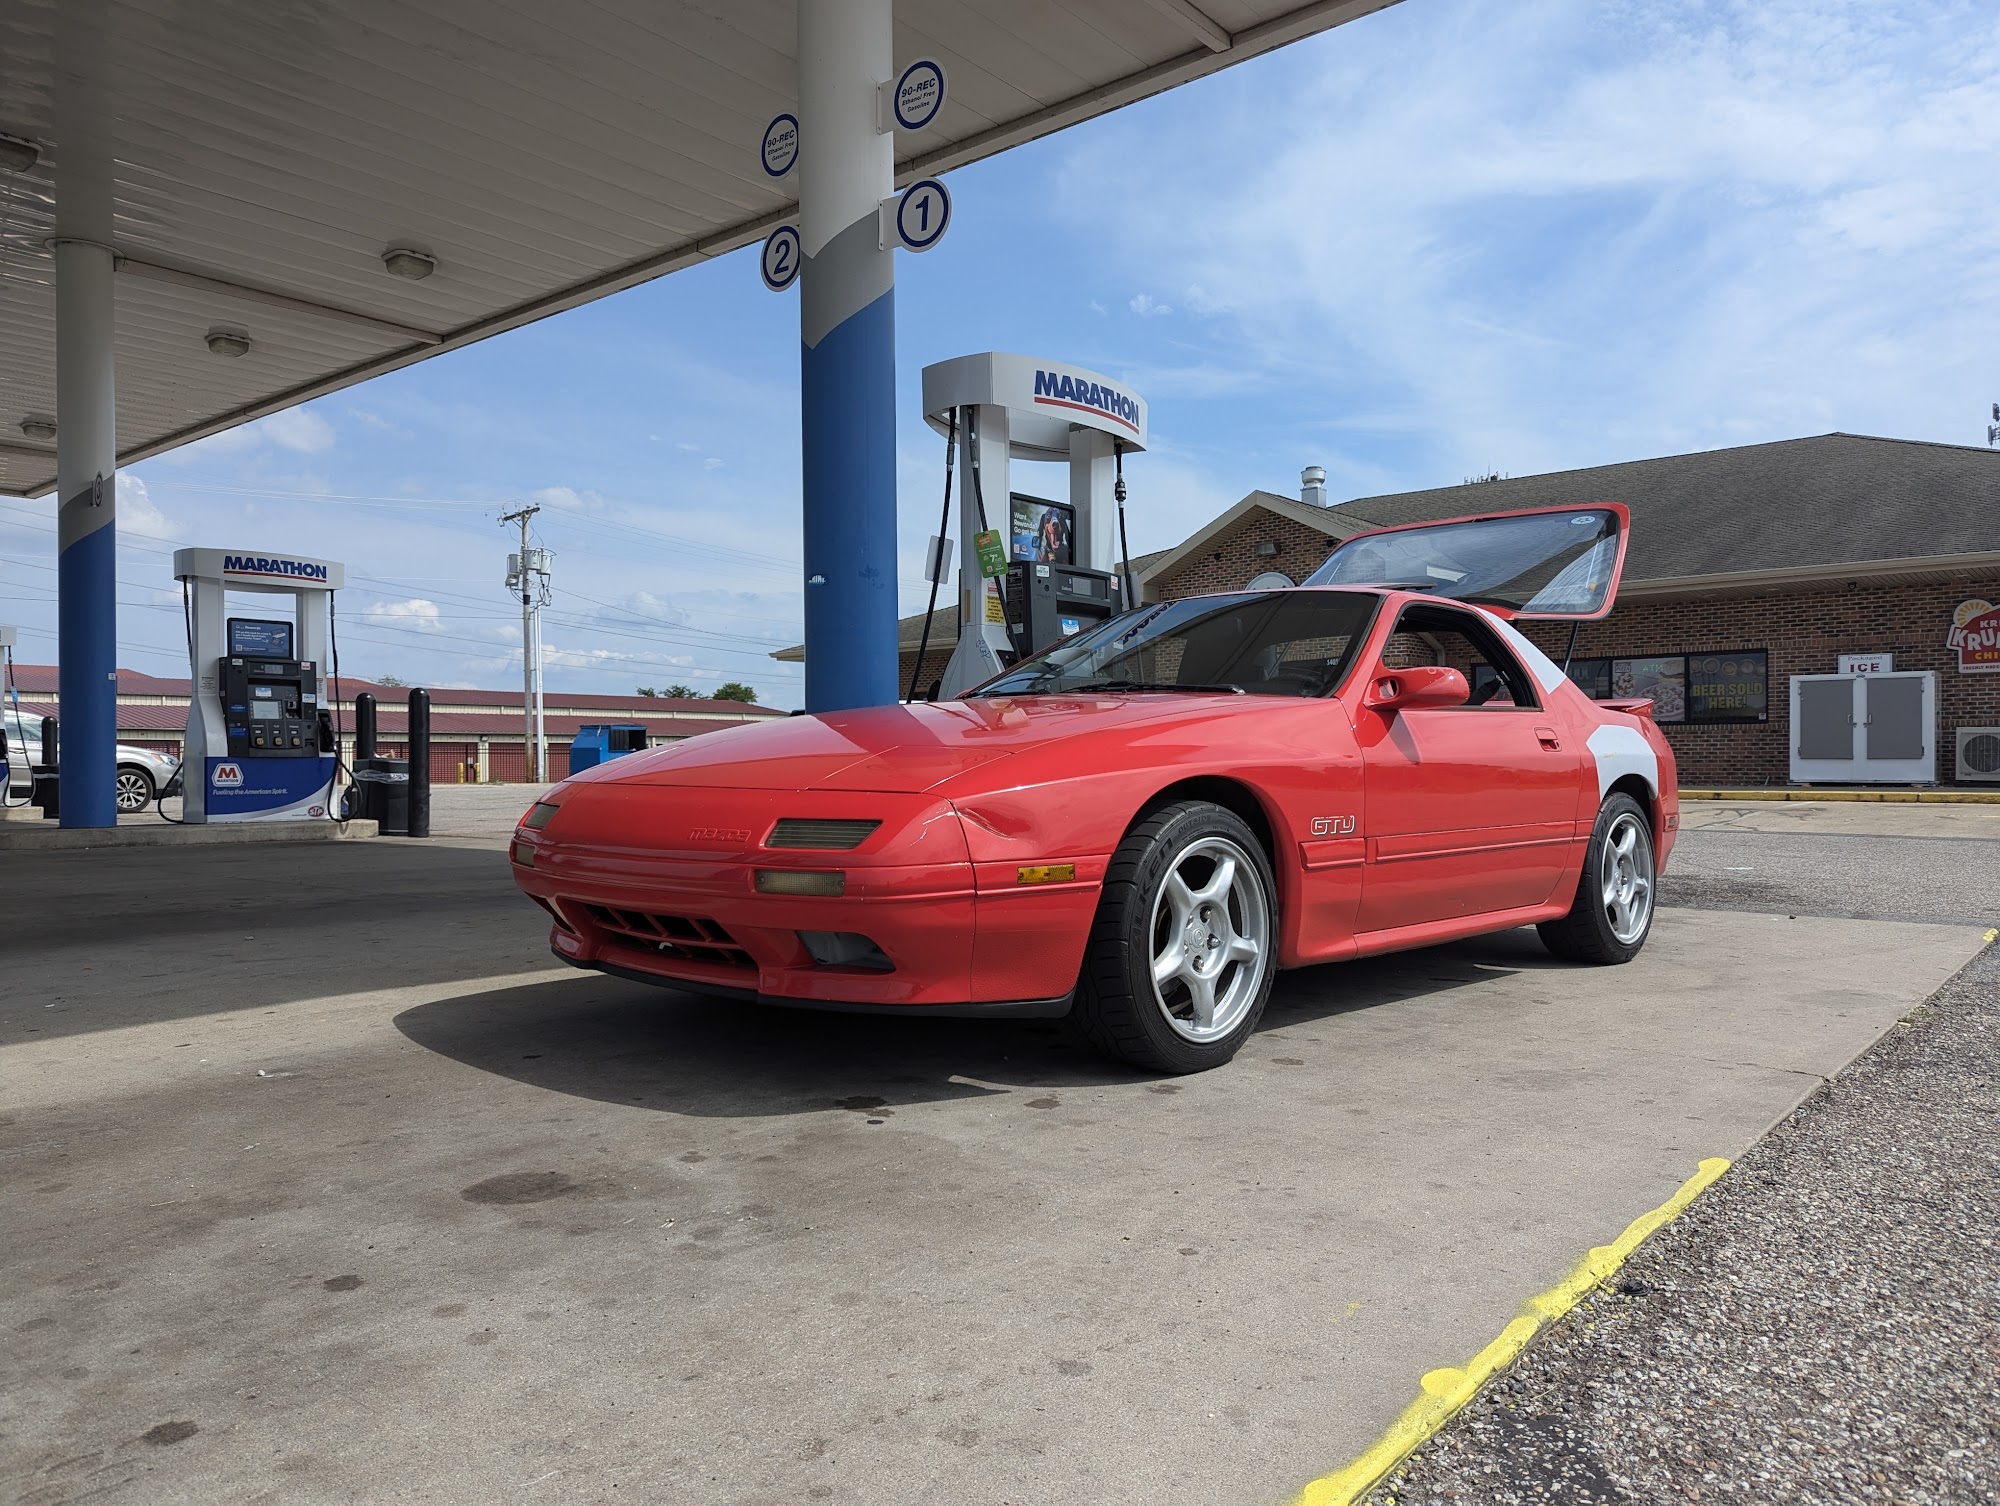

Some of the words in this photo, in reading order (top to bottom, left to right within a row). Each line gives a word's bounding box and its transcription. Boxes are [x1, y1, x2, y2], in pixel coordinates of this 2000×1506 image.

[901, 78, 936, 98] 90-REC
[902, 96, 922, 106] Ethanol
[923, 90, 936, 99] Free
[907, 101, 930, 112] Gasoline
[767, 129, 795, 148] 90-REC
[767, 146, 784, 156] Ethanol
[785, 141, 795, 149] Free
[771, 150, 790, 162] Gasoline
[915, 195, 929, 232] 1
[773, 239, 790, 275] 2
[1034, 369, 1139, 427] MARATHON
[1014, 511, 1027, 520] Want
[1013, 526, 1021, 534] Go
[224, 555, 327, 579] MARATHON
[1642, 663, 1665, 673] ATM
[1849, 662, 1880, 673] ICE
[1692, 683, 1726, 697] BEER
[1728, 682, 1763, 696] SOLD
[1708, 696, 1747, 709] HERE!
[218, 767, 238, 778] M
[309, 807, 323, 816] STP
[1310, 815, 1355, 836] GTU
